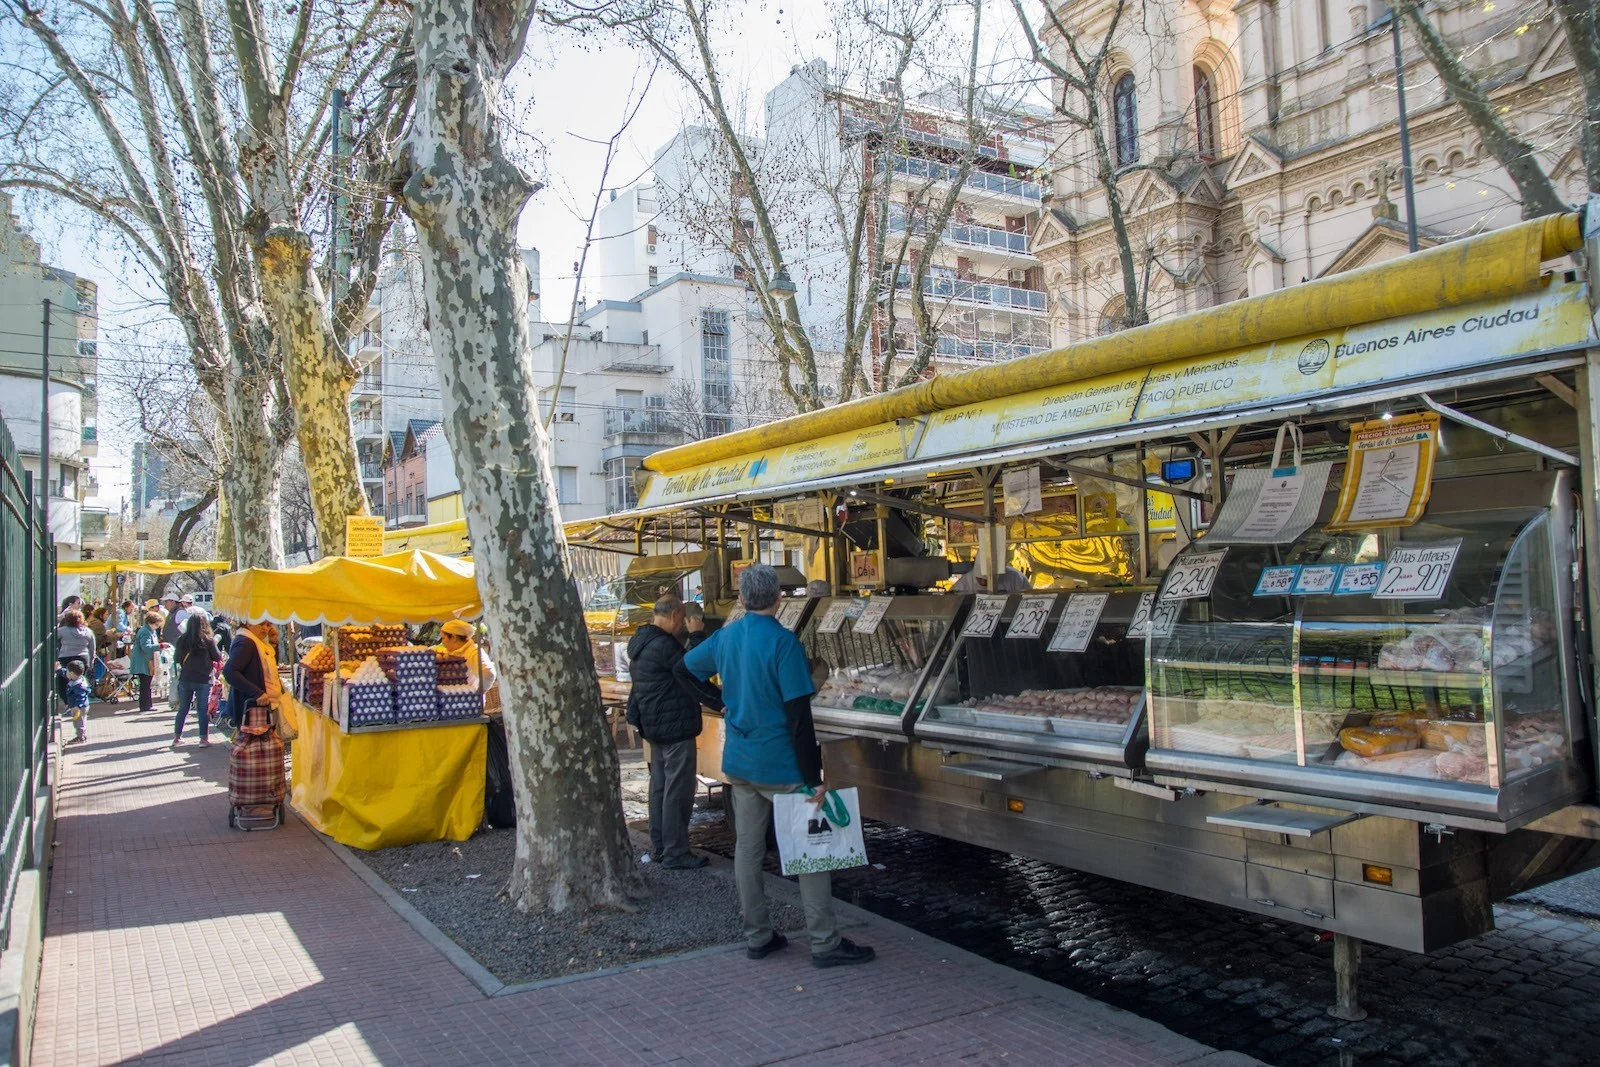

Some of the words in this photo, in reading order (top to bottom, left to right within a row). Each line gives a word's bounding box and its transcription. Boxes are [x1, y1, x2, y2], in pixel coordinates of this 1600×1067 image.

[1334, 335, 1398, 359] Buenos
[1403, 324, 1456, 345] Aires
[1462, 303, 1539, 333] Ciudad
[1042, 393, 1083, 407] Dirección
[1085, 383, 1122, 398] General
[1124, 380, 1138, 390] de
[1140, 372, 1171, 387] Ferias
[1174, 371, 1182, 381] y
[1184, 358, 1239, 378] Mercados
[990, 414, 1043, 433] MINISTERIO
[1045, 411, 1058, 423] DE
[1060, 401, 1114, 421] AMBIENTE
[1117, 398, 1126, 409] Y
[1125, 388, 1175, 408] ESPACIO
[1178, 377, 1234, 397] PÚBLICO
[1357, 431, 1382, 440] PRECIOS
[1384, 424, 1429, 436] CONCERTADOS
[1415, 432, 1428, 440] BA
[687, 472, 700, 493] de
[699, 469, 712, 490] la
[1391, 550, 1416, 564] Alitas
[857, 566, 875, 579] Caja
[1166, 571, 1184, 595] 2
[1182, 565, 1215, 592] 240
[1381, 566, 1402, 593] 2
[808, 817, 832, 835] BA
